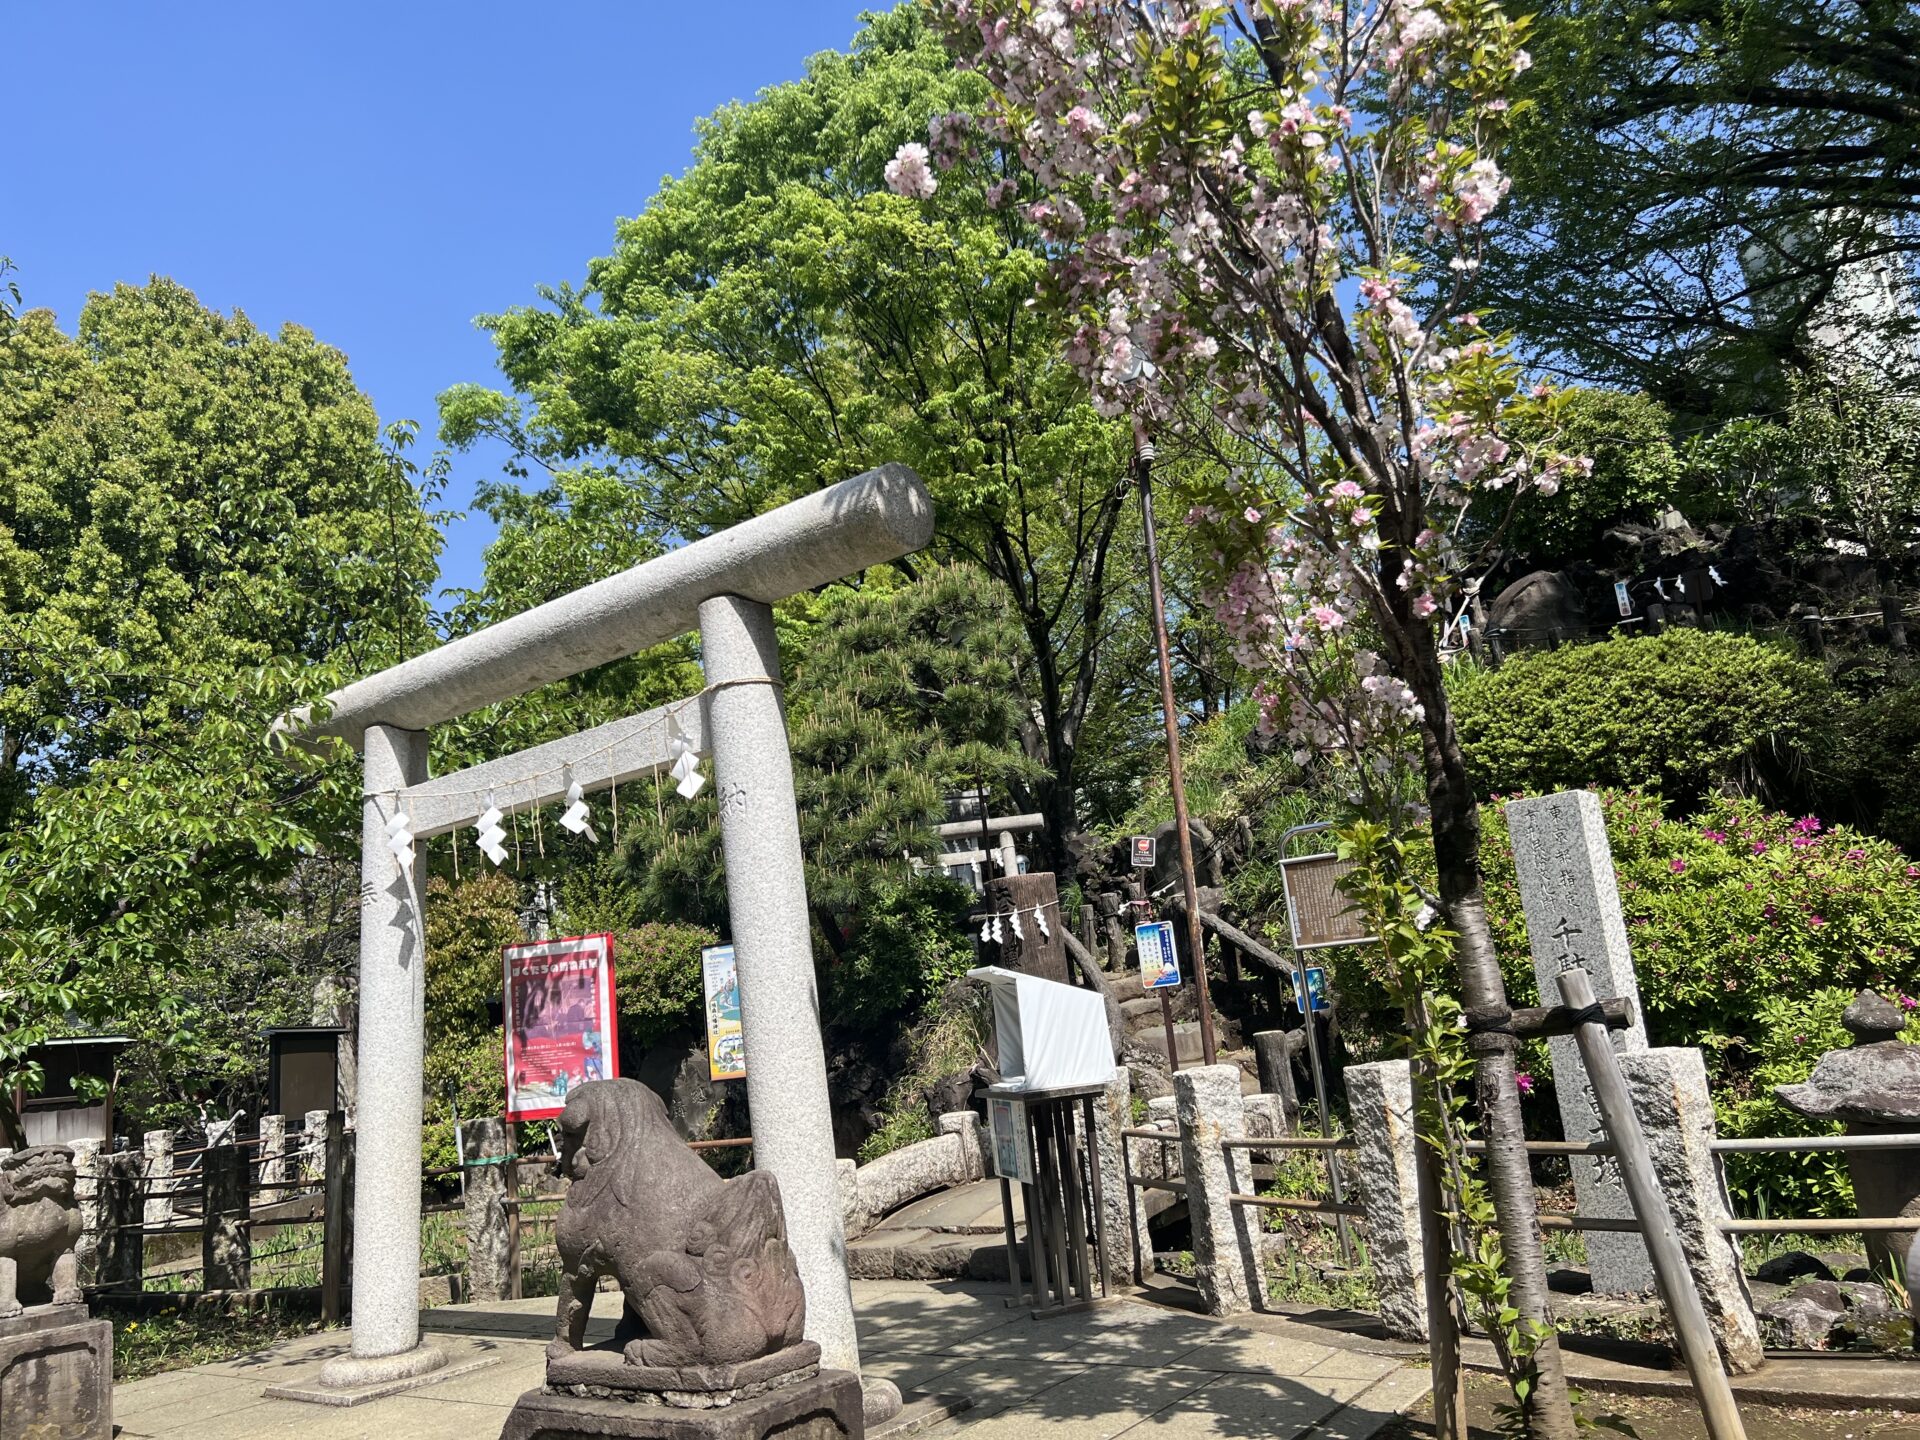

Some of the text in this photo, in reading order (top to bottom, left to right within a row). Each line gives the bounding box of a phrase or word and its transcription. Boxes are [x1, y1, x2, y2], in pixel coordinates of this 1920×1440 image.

[1547, 804, 1581, 910] 東京都指定
